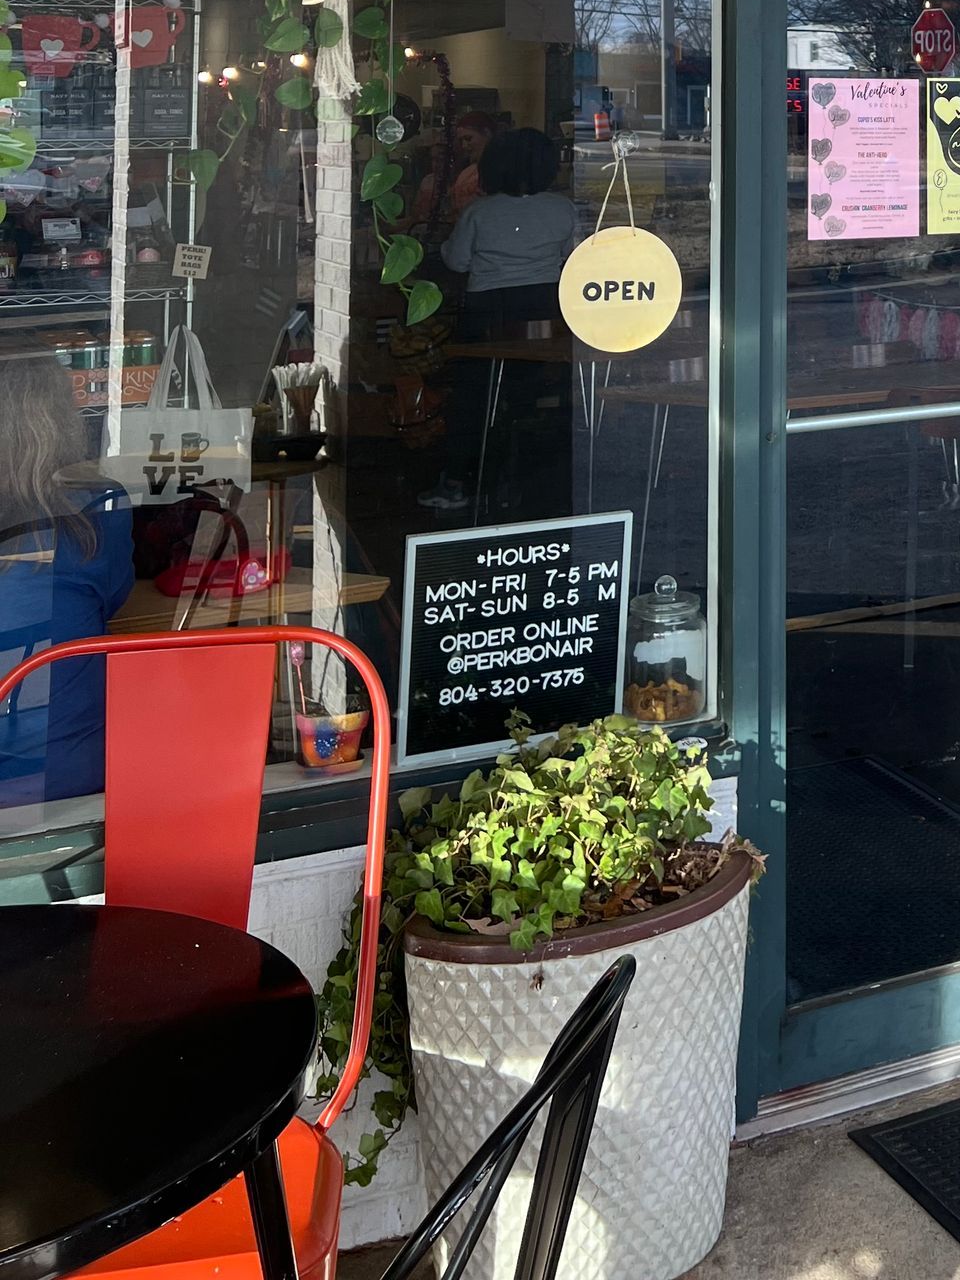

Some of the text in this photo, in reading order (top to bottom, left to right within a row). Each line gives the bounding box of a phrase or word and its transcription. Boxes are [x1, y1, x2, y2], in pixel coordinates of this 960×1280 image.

[851, 81, 908, 101] Valentine's
[583, 281, 655, 301] OPEN
[486, 543, 562, 567] HOURS
[545, 567, 580, 587] 7-5
[588, 560, 618, 581] PM
[543, 588, 579, 609] 8-5
[598, 582, 616, 601] M
[440, 614, 600, 653] ORDER ONLINE
[447, 637, 593, 675] @PERKBONAIR
[438, 667, 585, 706] 804-320-7375
